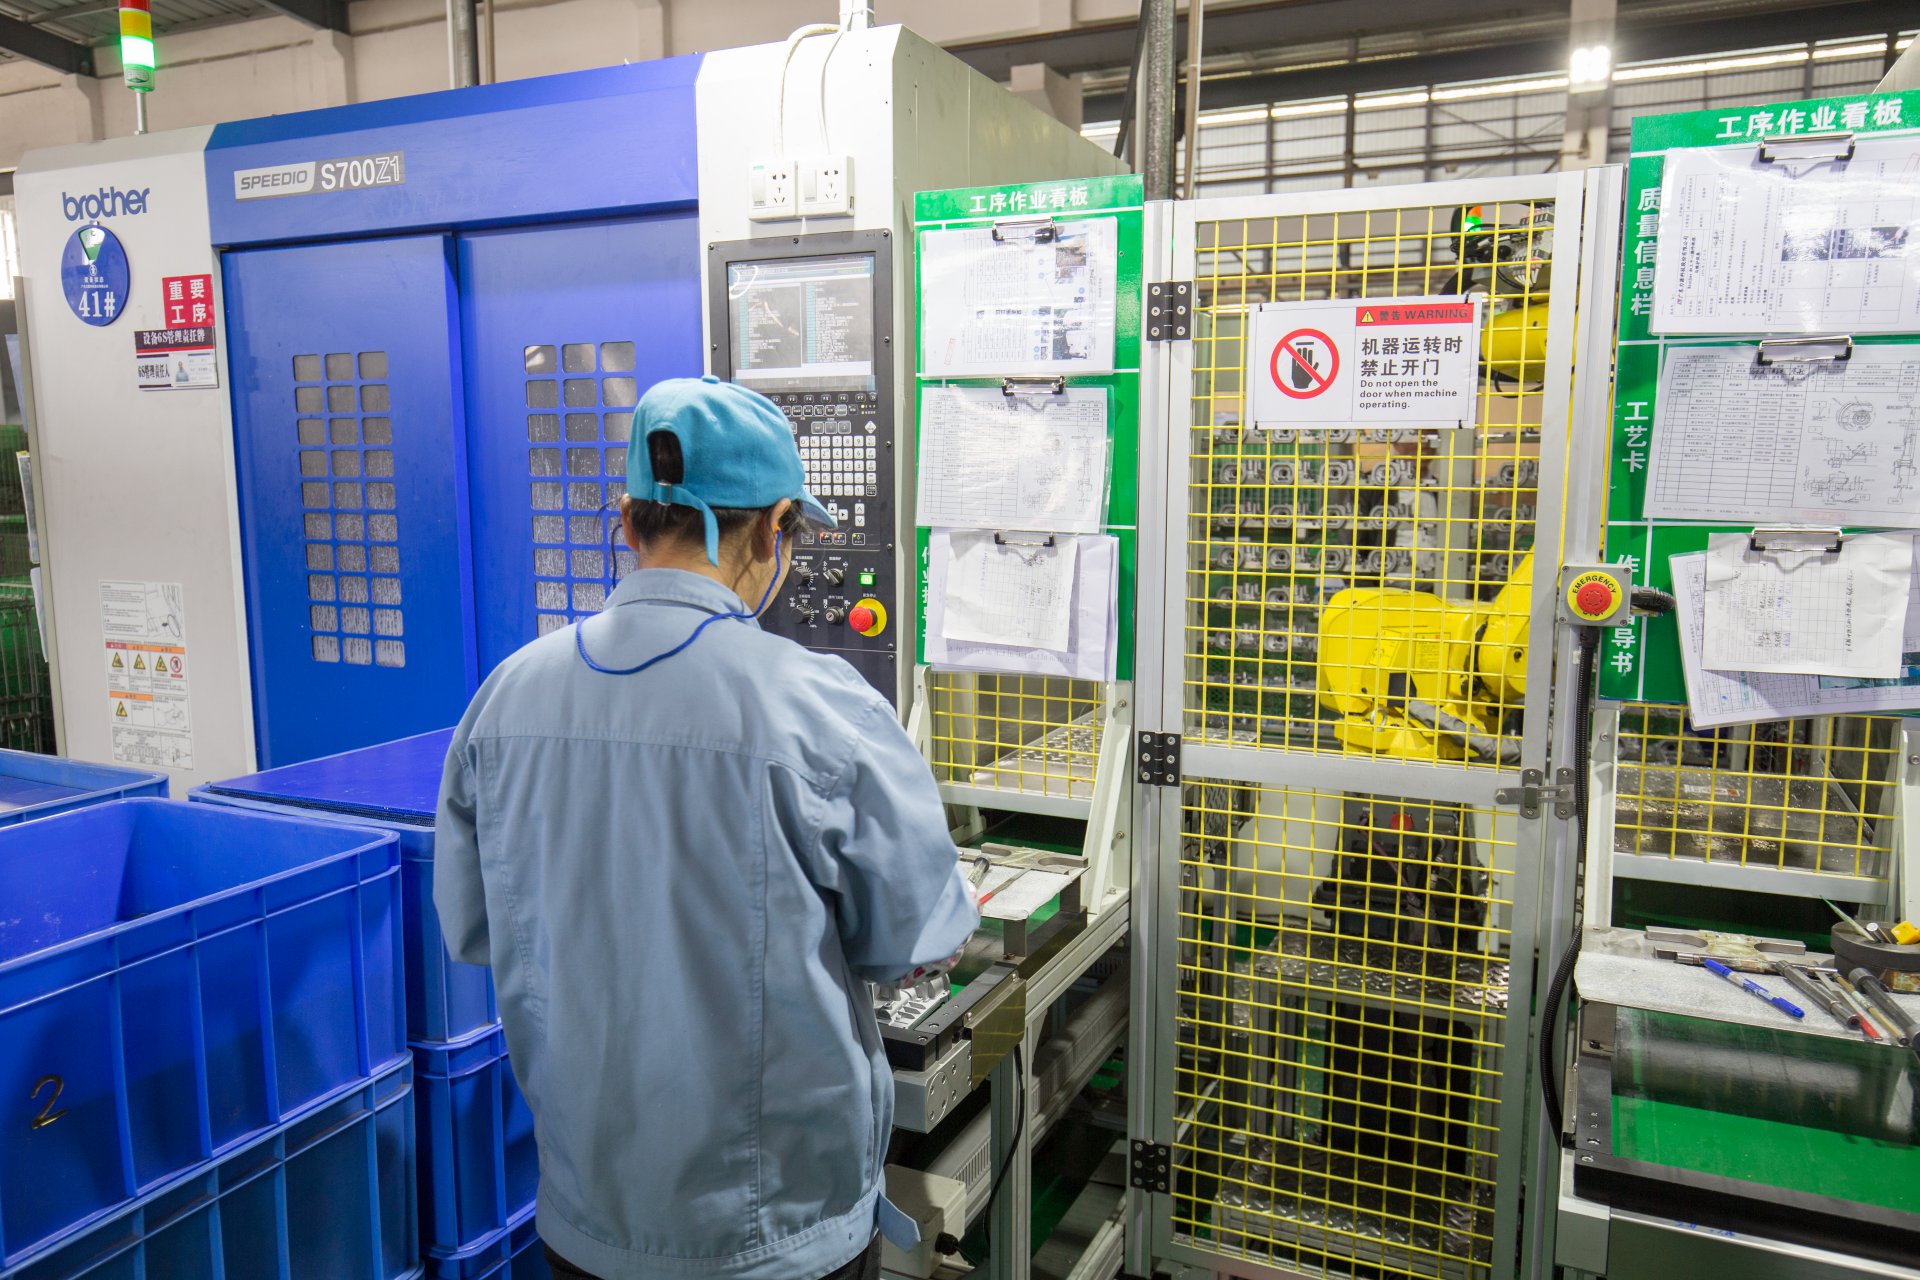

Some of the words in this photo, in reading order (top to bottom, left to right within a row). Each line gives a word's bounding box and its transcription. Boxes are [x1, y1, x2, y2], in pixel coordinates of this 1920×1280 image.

[1715, 97, 1904, 139] 工序作业看板
[240, 170, 308, 191] SPEEDIO
[320, 155, 401, 190] S700Z1
[62, 186, 150, 221] brother
[969, 186, 1089, 213] 工序作业看板
[1630, 186, 1662, 316] 质量信息栏
[168, 278, 205, 301] 重要
[78, 290, 116, 317] 41#
[171, 302, 207, 324] 工序
[1379, 310, 1400, 321] 警告
[1404, 308, 1469, 320] WARNING
[1361, 335, 1463, 356] 机器运转时
[1360, 358, 1440, 377] 禁止开门
[1360, 379, 1374, 388] Do
[1375, 380, 1393, 388] not
[1394, 381, 1420, 389] open
[1421, 379, 1439, 387] the
[1360, 390, 1383, 398] door
[1384, 390, 1412, 398] when
[1414, 389, 1458, 397] machine
[1359, 400, 1411, 410] operating.
[1621, 401, 1649, 474] 工艺卡
[1571, 574, 1617, 595] EMERGENCY
[1610, 554, 1641, 677] 作导书
[30, 1074, 68, 1129] 2
